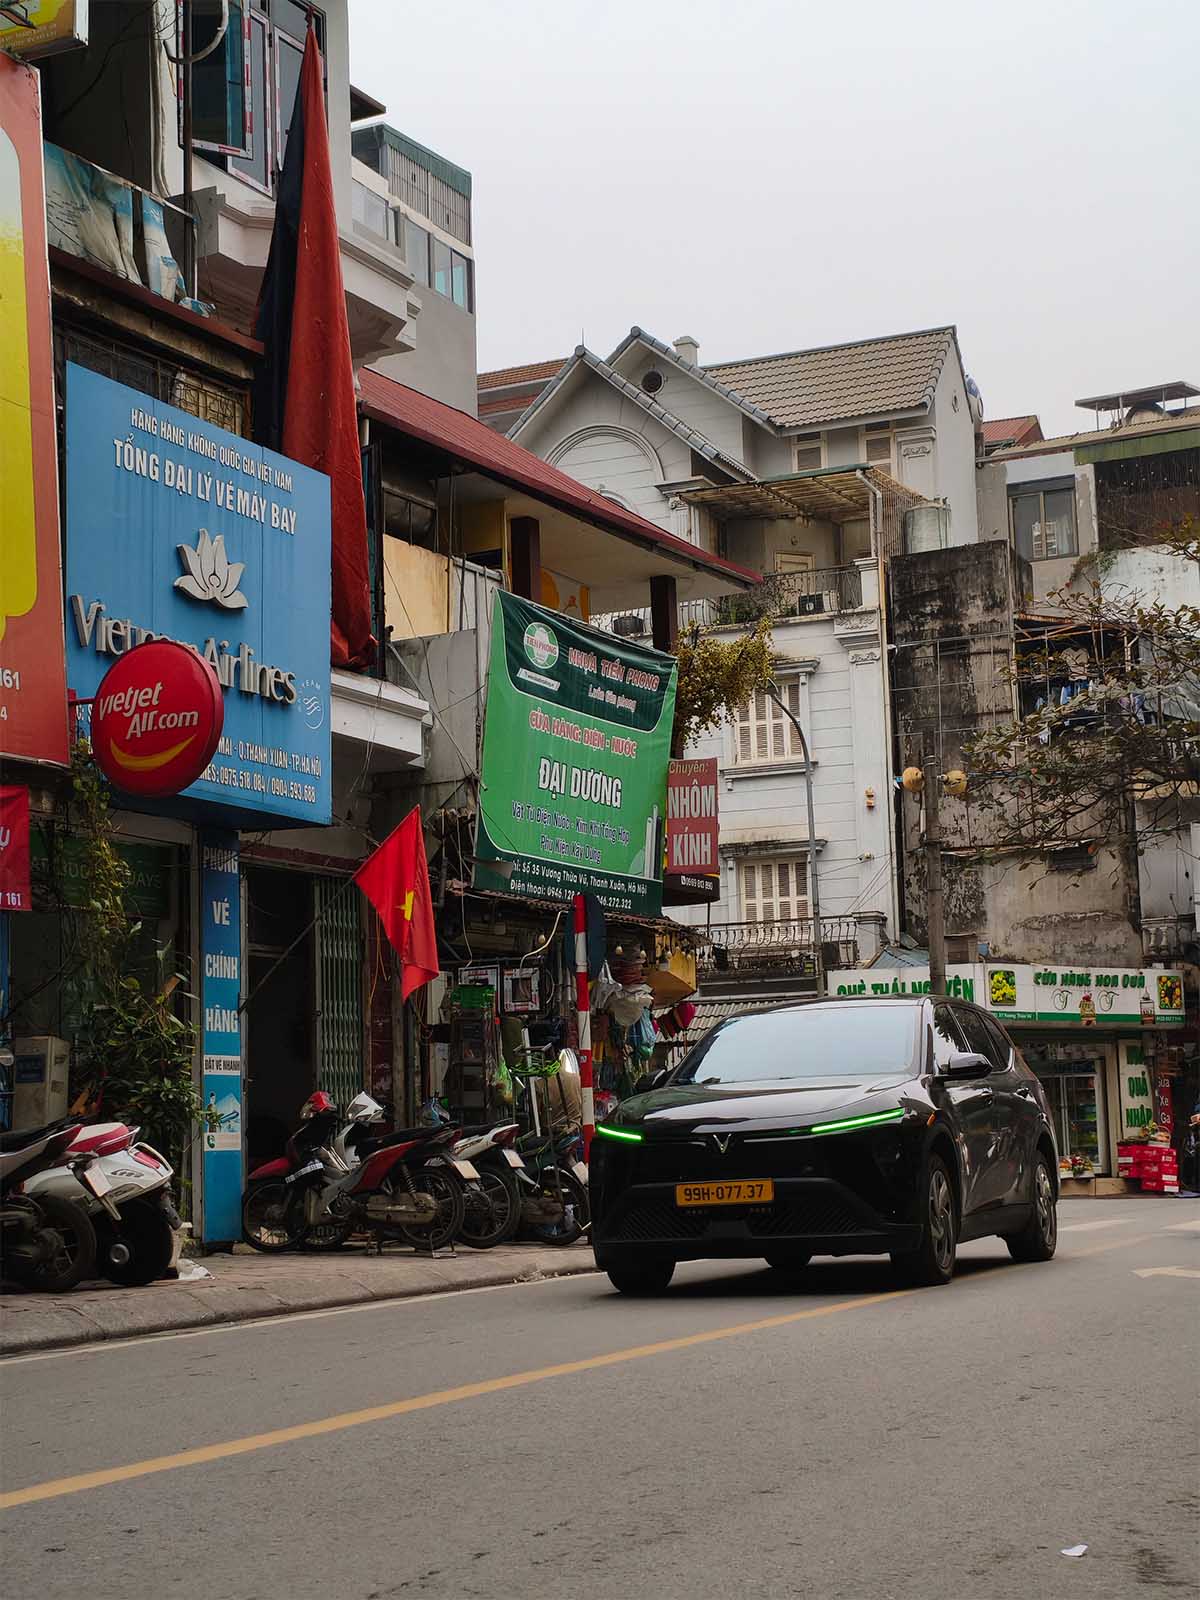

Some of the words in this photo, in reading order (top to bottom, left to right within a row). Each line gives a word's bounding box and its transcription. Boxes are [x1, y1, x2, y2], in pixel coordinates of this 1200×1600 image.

[114, 433, 160, 482] TỔNG
[164, 459, 192, 496] ĐẠI
[197, 472, 212, 502] LÝ
[216, 480, 234, 512] VÉ
[237, 490, 267, 524] MÁY
[271, 506, 298, 535] BAY
[242, 456, 256, 479] GIA
[274, 470, 293, 493] NAM
[202, 637, 297, 705] Airlines
[625, 668, 660, 692] PHONG
[529, 708, 551, 733] CỬA
[538, 756, 566, 799] ĐẠI
[569, 767, 623, 809] DƯƠNG
[668, 779, 716, 819] NHÔM
[673, 826, 711, 866] KÍNH
[532, 864, 540, 876] 35
[590, 876, 608, 888] Thanh
[212, 898, 231, 926] VÉ
[205, 950, 239, 980] CHÍNH
[684, 1183, 764, 1202] 99H-077.37
